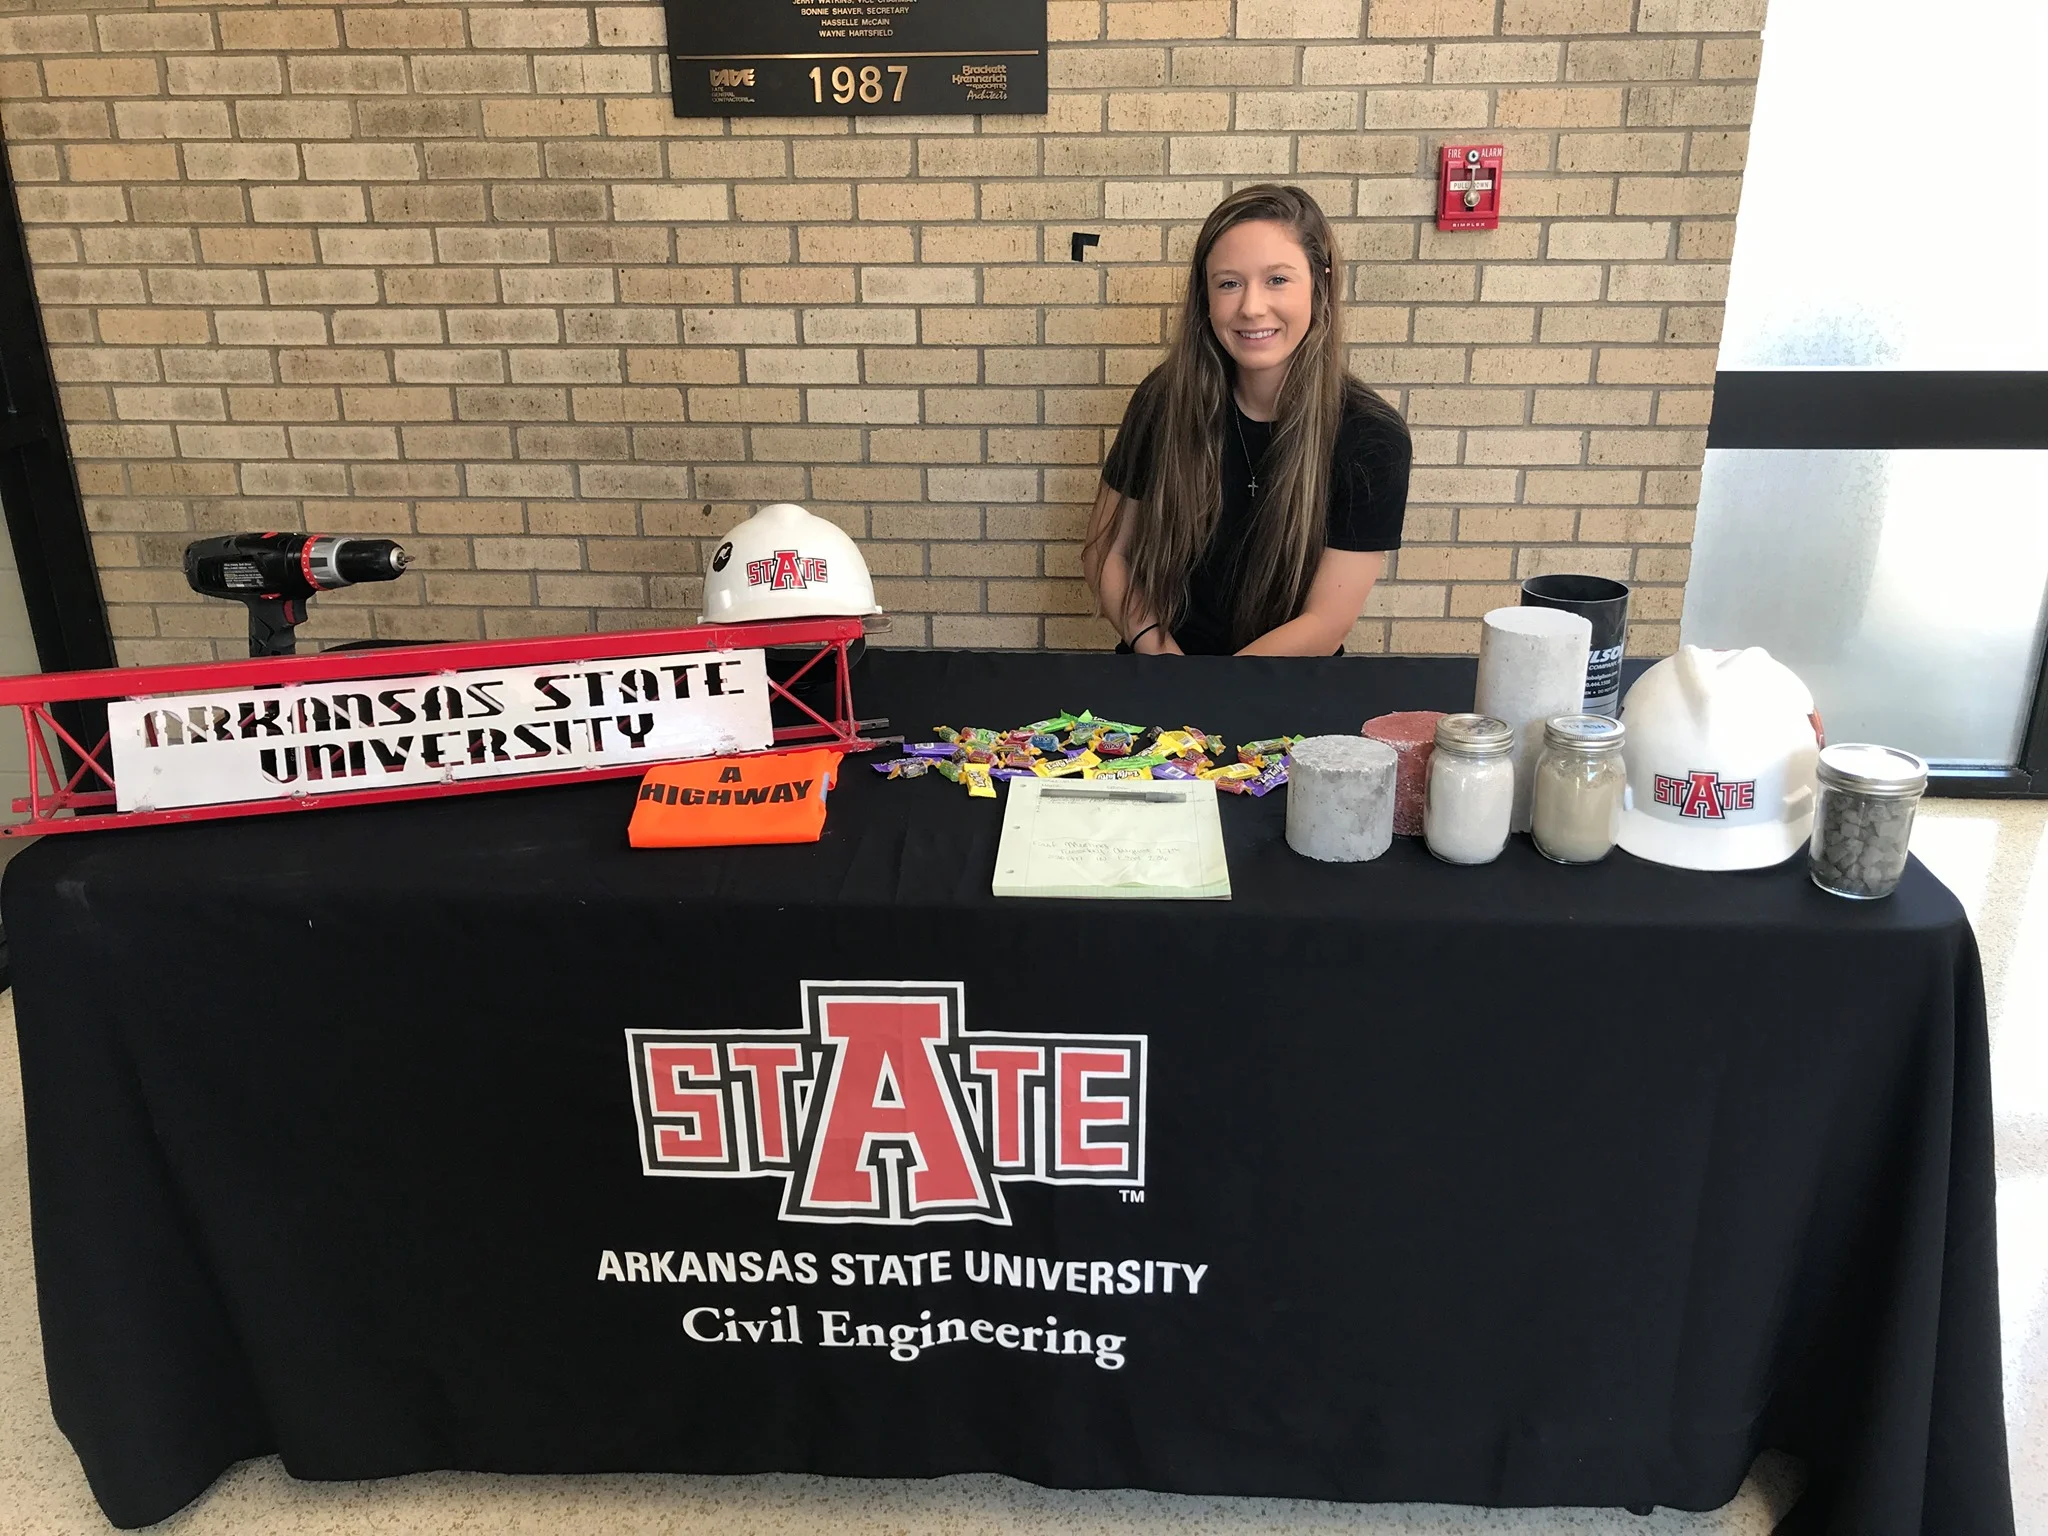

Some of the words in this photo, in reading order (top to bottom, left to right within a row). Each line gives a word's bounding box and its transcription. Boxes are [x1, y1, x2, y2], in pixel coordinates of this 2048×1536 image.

[801, 8, 829, 16] BONNIE
[832, 7, 864, 16] SHAVER,
[866, 6, 910, 15] SECRETARY
[819, 30, 846, 38] WAYNE
[849, 29, 894, 37] HARTSFIELD
[821, 19, 859, 27] HASSELLE
[861, 18, 890, 26] McCAIN
[952, 73, 1007, 85] Krennerich
[962, 64, 1007, 75] Brackett
[808, 65, 908, 103] 1987
[966, 89, 1008, 101] Architects
[1448, 148, 1461, 159] FIRE
[1481, 147, 1503, 158] ALARM
[747, 549, 828, 591] STATE
[137, 681, 504, 748] ARKANSAS
[534, 660, 745, 712] STATE
[260, 713, 654, 785] UNIVERSITY
[718, 766, 743, 783] A
[638, 779, 814, 806] HIGHWAY
[1654, 770, 1756, 820] STATE
[625, 979, 1149, 1227] STATE
[1119, 1189, 1146, 1203] TM
[597, 1248, 819, 1286] ARKANSAS
[830, 1249, 953, 1287] STATE
[964, 1249, 1209, 1296] UNIVERSITY
[682, 1304, 804, 1344] Civil
[817, 1308, 1127, 1371] Engineering
